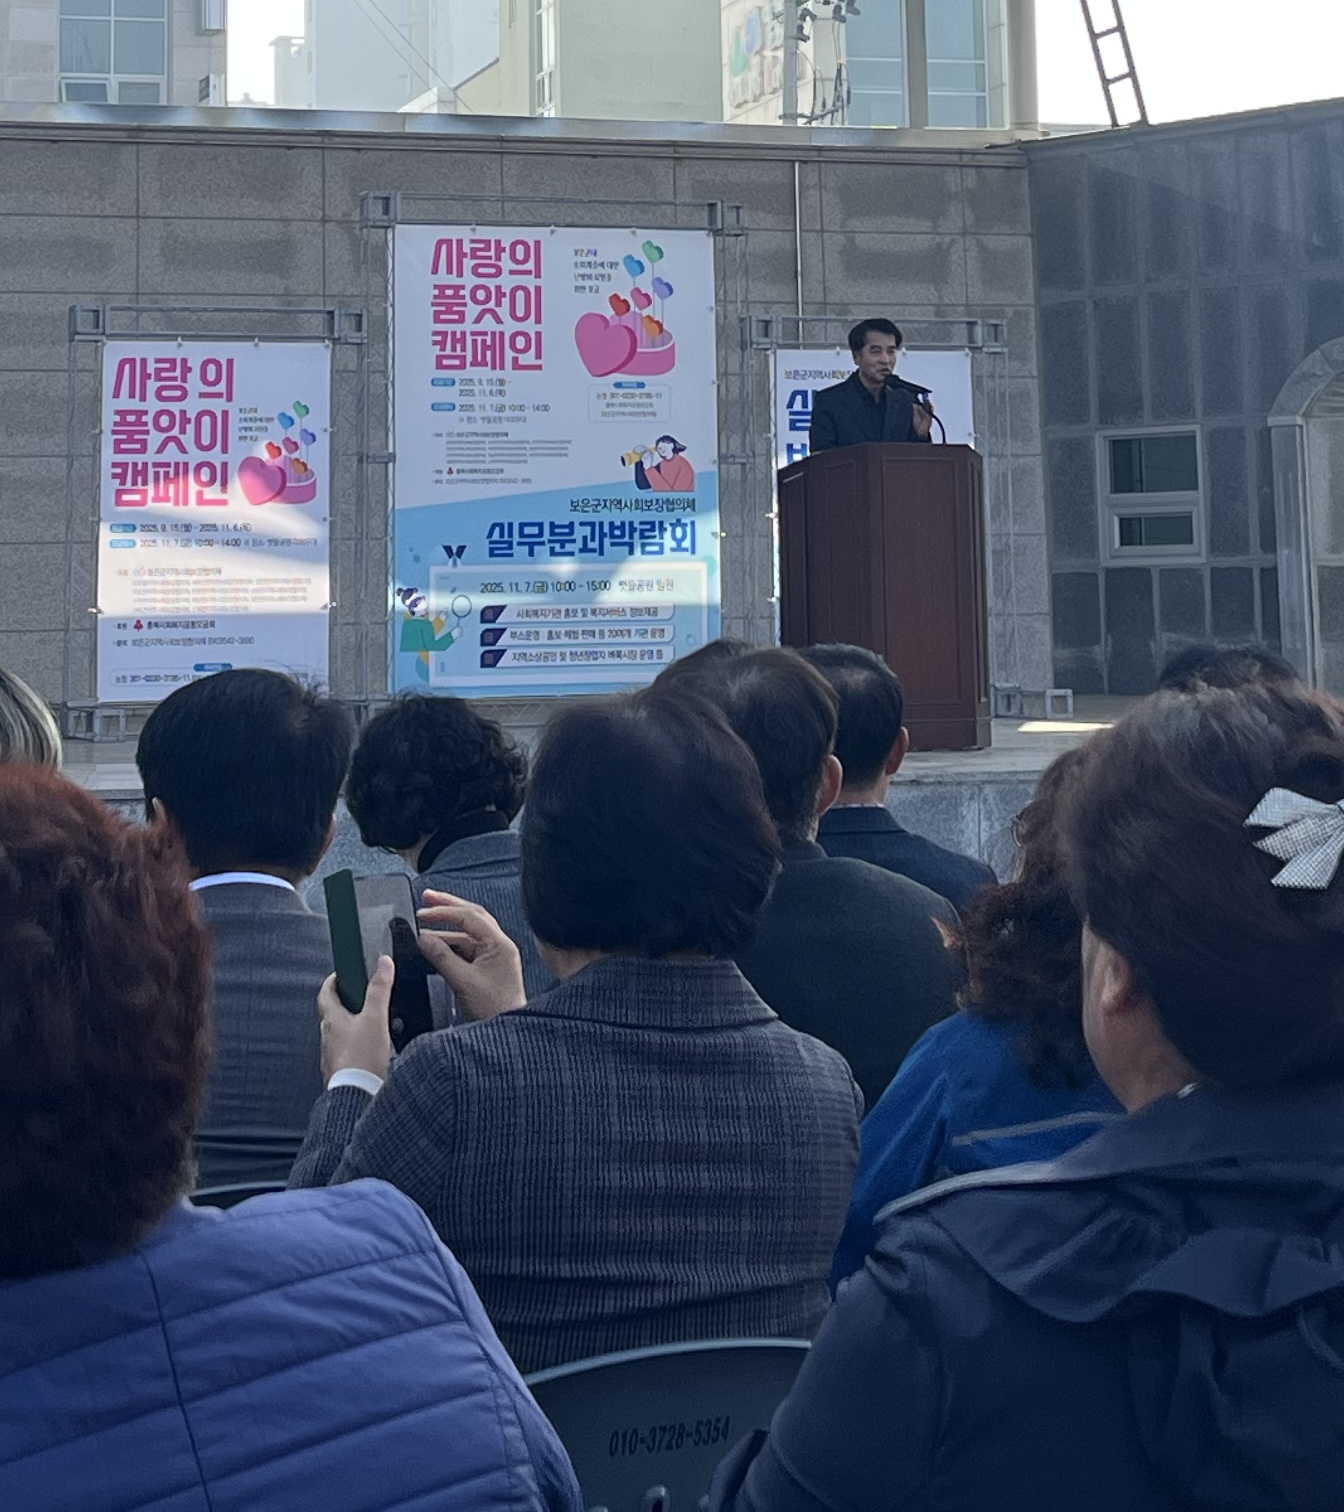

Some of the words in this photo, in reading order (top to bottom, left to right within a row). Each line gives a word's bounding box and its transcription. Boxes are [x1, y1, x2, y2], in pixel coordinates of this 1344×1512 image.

[431, 238, 542, 279] 사랑의
[431, 284, 542, 325] 품앗이
[431, 330, 543, 371] 캠페인
[112, 357, 234, 403] 사랑의
[111, 409, 229, 455] 품앗이
[111, 461, 229, 507] 캠페인
[569, 498, 697, 513] 보은군지역사회보장협의체
[485, 519, 697, 558] 실무분과박람회
[480, 582, 507, 594] 2025.
[509, 581, 523, 594] 11.
[524, 581, 548, 594] 7.(금)
[550, 580, 576, 592] 10:00
[586, 580, 611, 592] 15:00
[516, 607, 562, 619] 사회복지기관
[608, 1415, 731, 1457] 010-3728-5354
